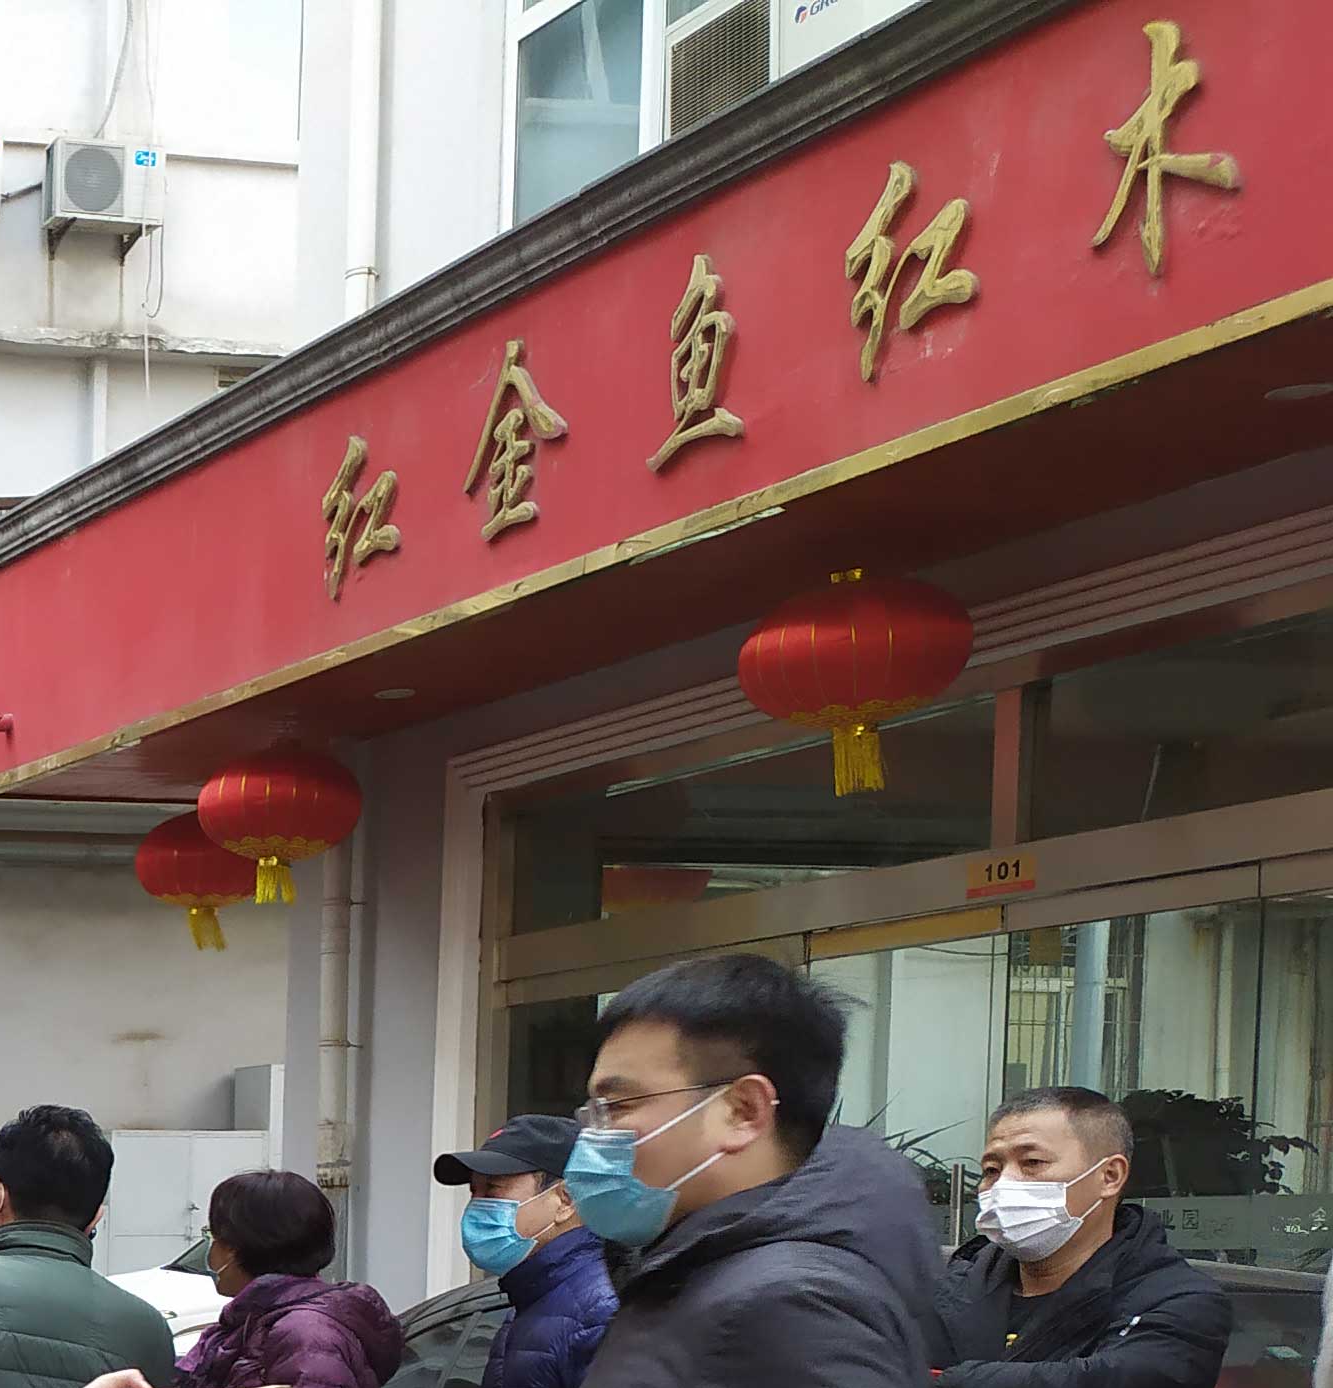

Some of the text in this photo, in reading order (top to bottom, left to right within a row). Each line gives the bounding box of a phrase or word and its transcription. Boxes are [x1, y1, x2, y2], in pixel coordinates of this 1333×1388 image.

[319, 18, 1241, 602] 红金鱼红木
[985, 859, 1020, 882] 101
